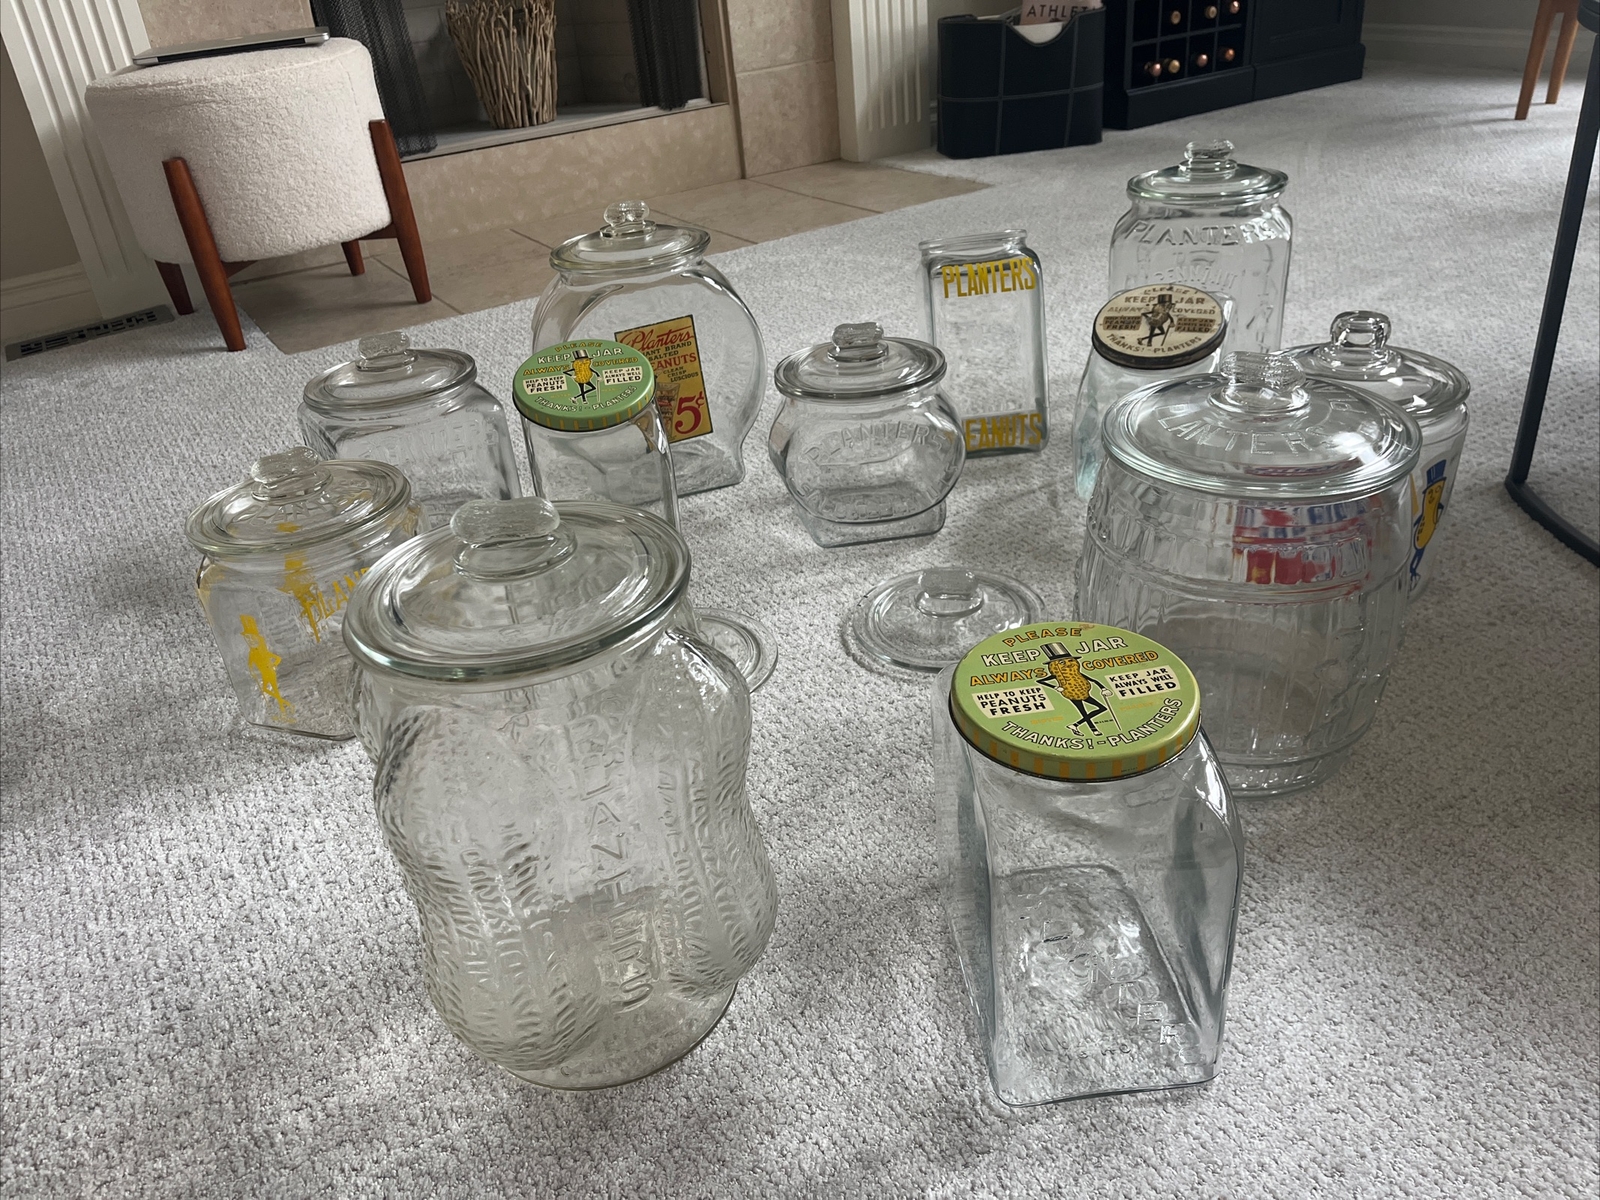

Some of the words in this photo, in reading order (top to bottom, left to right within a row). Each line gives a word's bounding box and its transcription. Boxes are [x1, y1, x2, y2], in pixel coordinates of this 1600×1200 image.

[1026, 4, 1096, 18] ATHLE
[1125, 219, 1279, 246] PLANTERS
[942, 257, 1036, 299] PLANTERS
[1124, 296, 1158, 304] KEEP
[1175, 296, 1206, 305] JAR
[620, 325, 695, 351] Planters
[664, 340, 692, 352] BRAND
[1153, 336, 1202, 354] PLANTERS
[537, 353, 572, 364] KEEP
[591, 347, 624, 358] JAR
[554, 341, 604, 353] PLEASE
[648, 350, 679, 361] SALTED
[523, 364, 571, 376] ALWAYS
[592, 357, 639, 367] COVERED
[651, 353, 697, 371] EANUTS
[663, 366, 684, 375] CLEAN
[606, 375, 641, 384] FILLED
[667, 369, 687, 378] CRISP
[670, 371, 699, 383] LUSCIOUS
[526, 380, 565, 389] PEANUTS
[530, 385, 563, 394] FRESH
[592, 385, 637, 410] PLANTERS
[962, 413, 1042, 451] EANUTS
[804, 421, 947, 462] PLANTERS
[1002, 626, 1082, 647] PLEASE
[981, 648, 1042, 667] KEEP
[1075, 636, 1128, 656] JAR
[970, 667, 1048, 687] ALWAYS
[1082, 650, 1159, 671] COVERED
[1108, 671, 1140, 683] KEEP
[1145, 667, 1169, 678] JAR
[1114, 677, 1149, 690] ALWAYS
[1150, 673, 1174, 686] WELL
[1119, 681, 1178, 698] FILLED
[976, 691, 1001, 702] HELP
[1002, 689, 1016, 699] TO
[1019, 686, 1042, 696] KEEP
[980, 693, 1047, 709] PEANUTS
[989, 702, 1047, 717] FRESH
[1106, 697, 1184, 748] PLANTERS
